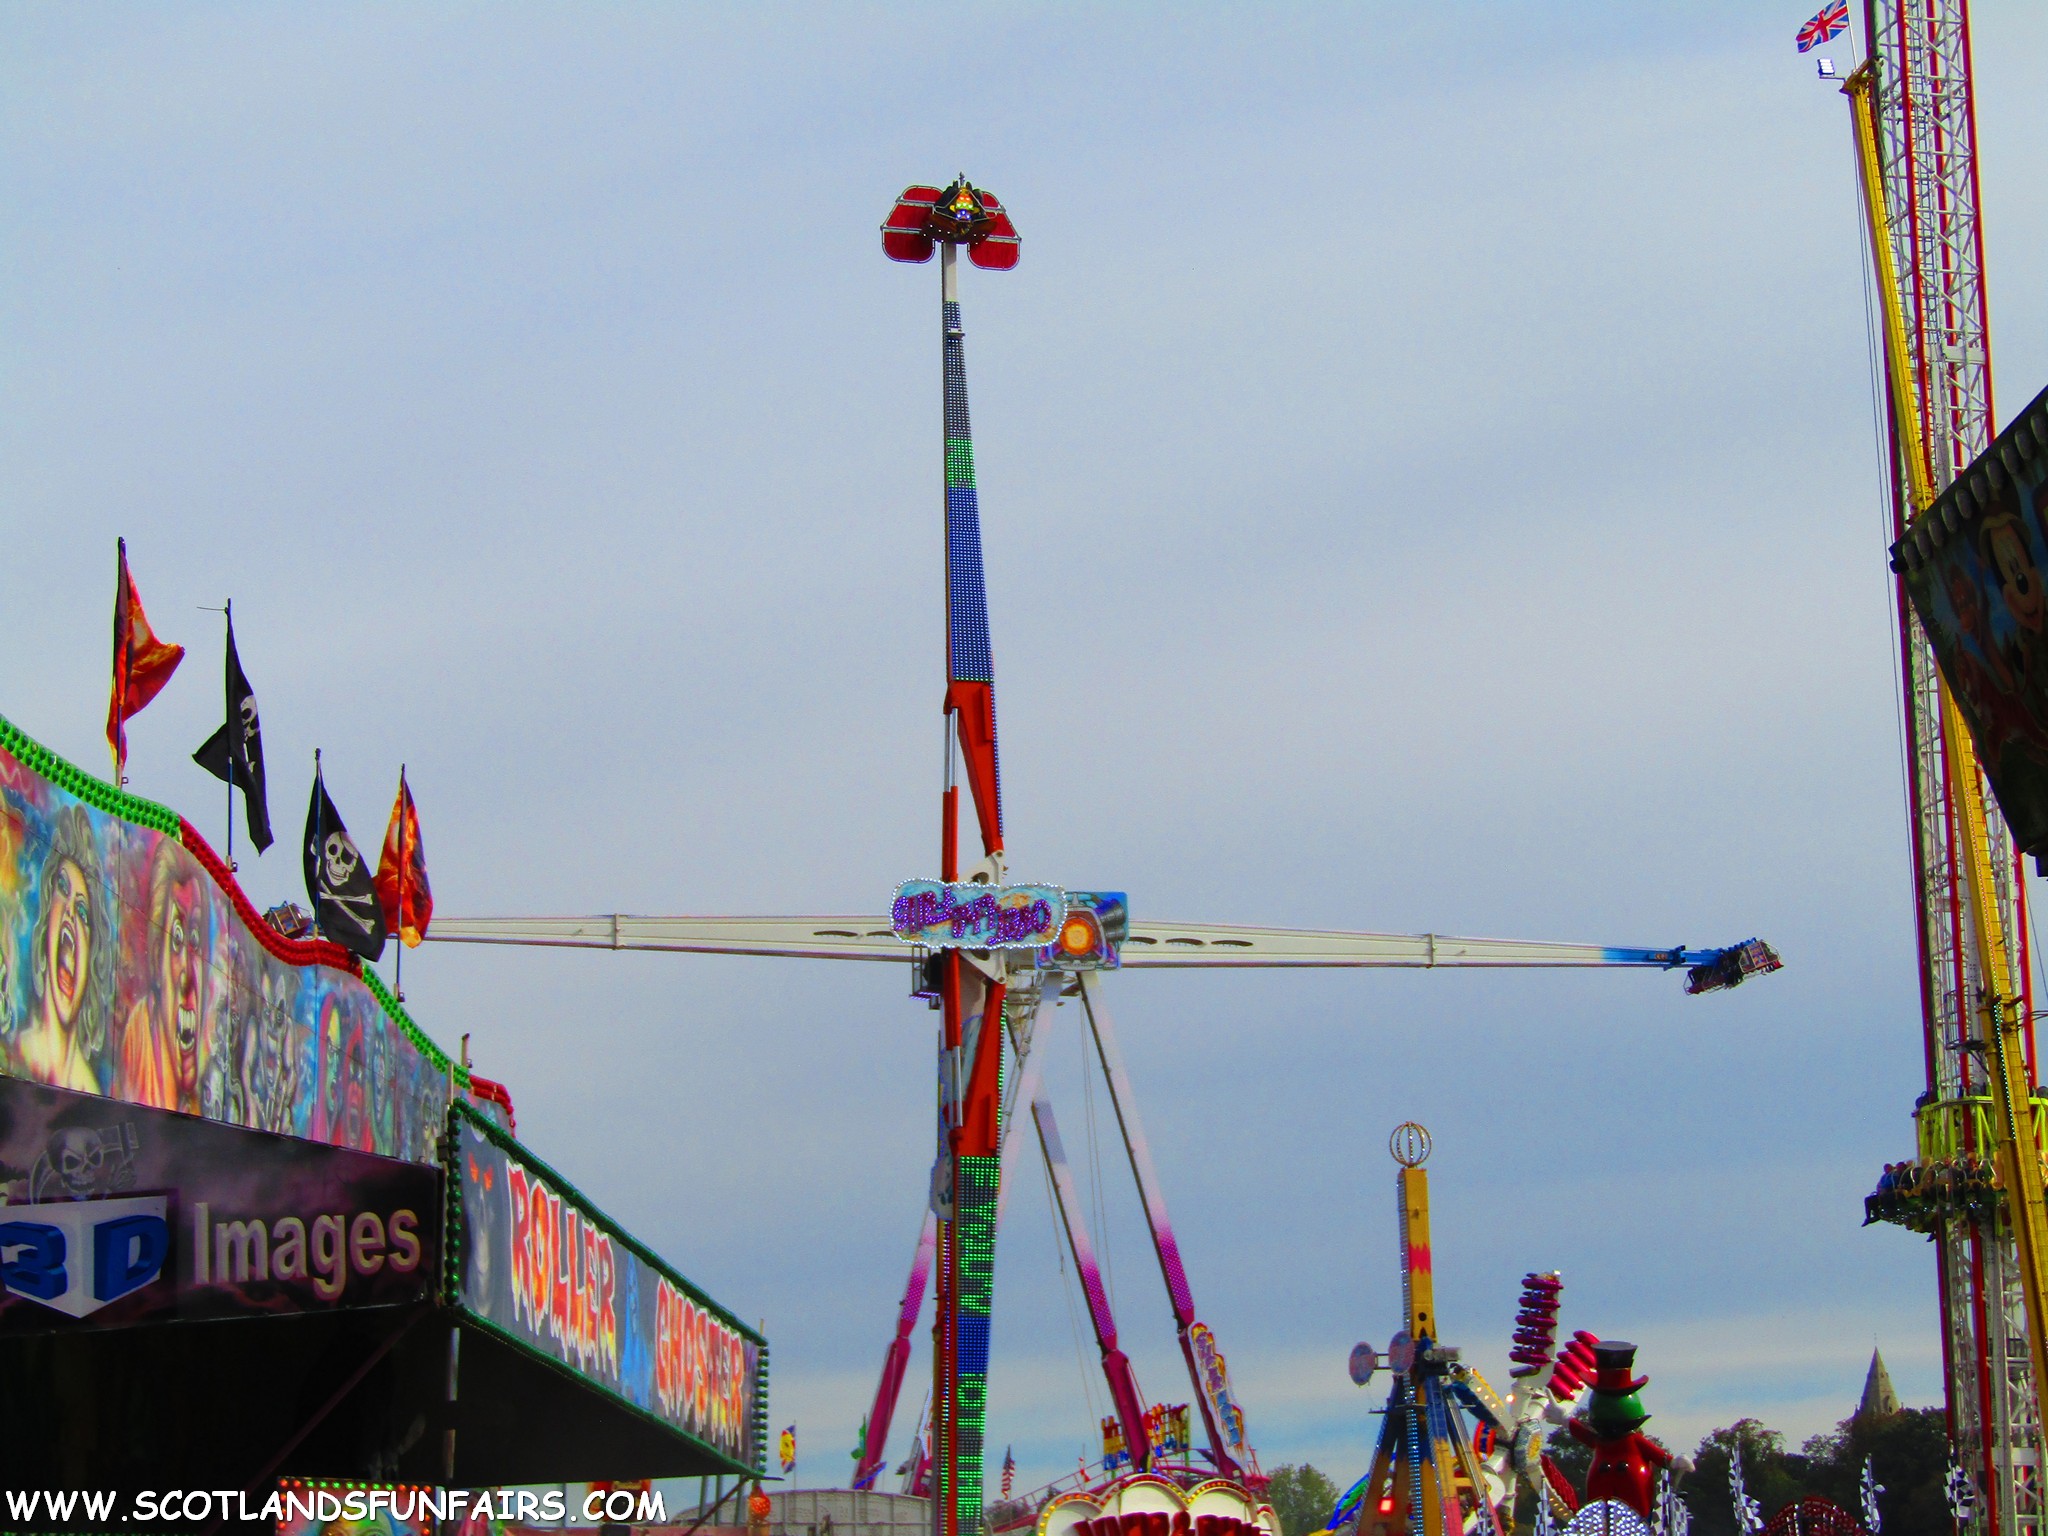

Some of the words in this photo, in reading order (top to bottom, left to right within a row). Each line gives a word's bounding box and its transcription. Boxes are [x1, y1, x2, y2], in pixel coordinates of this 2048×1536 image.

[0, 1214, 170, 1301] 3D
[193, 1200, 422, 1302] Images
[505, 1158, 618, 1382] ROLLER
[655, 1274, 745, 1453] GHOSTER
